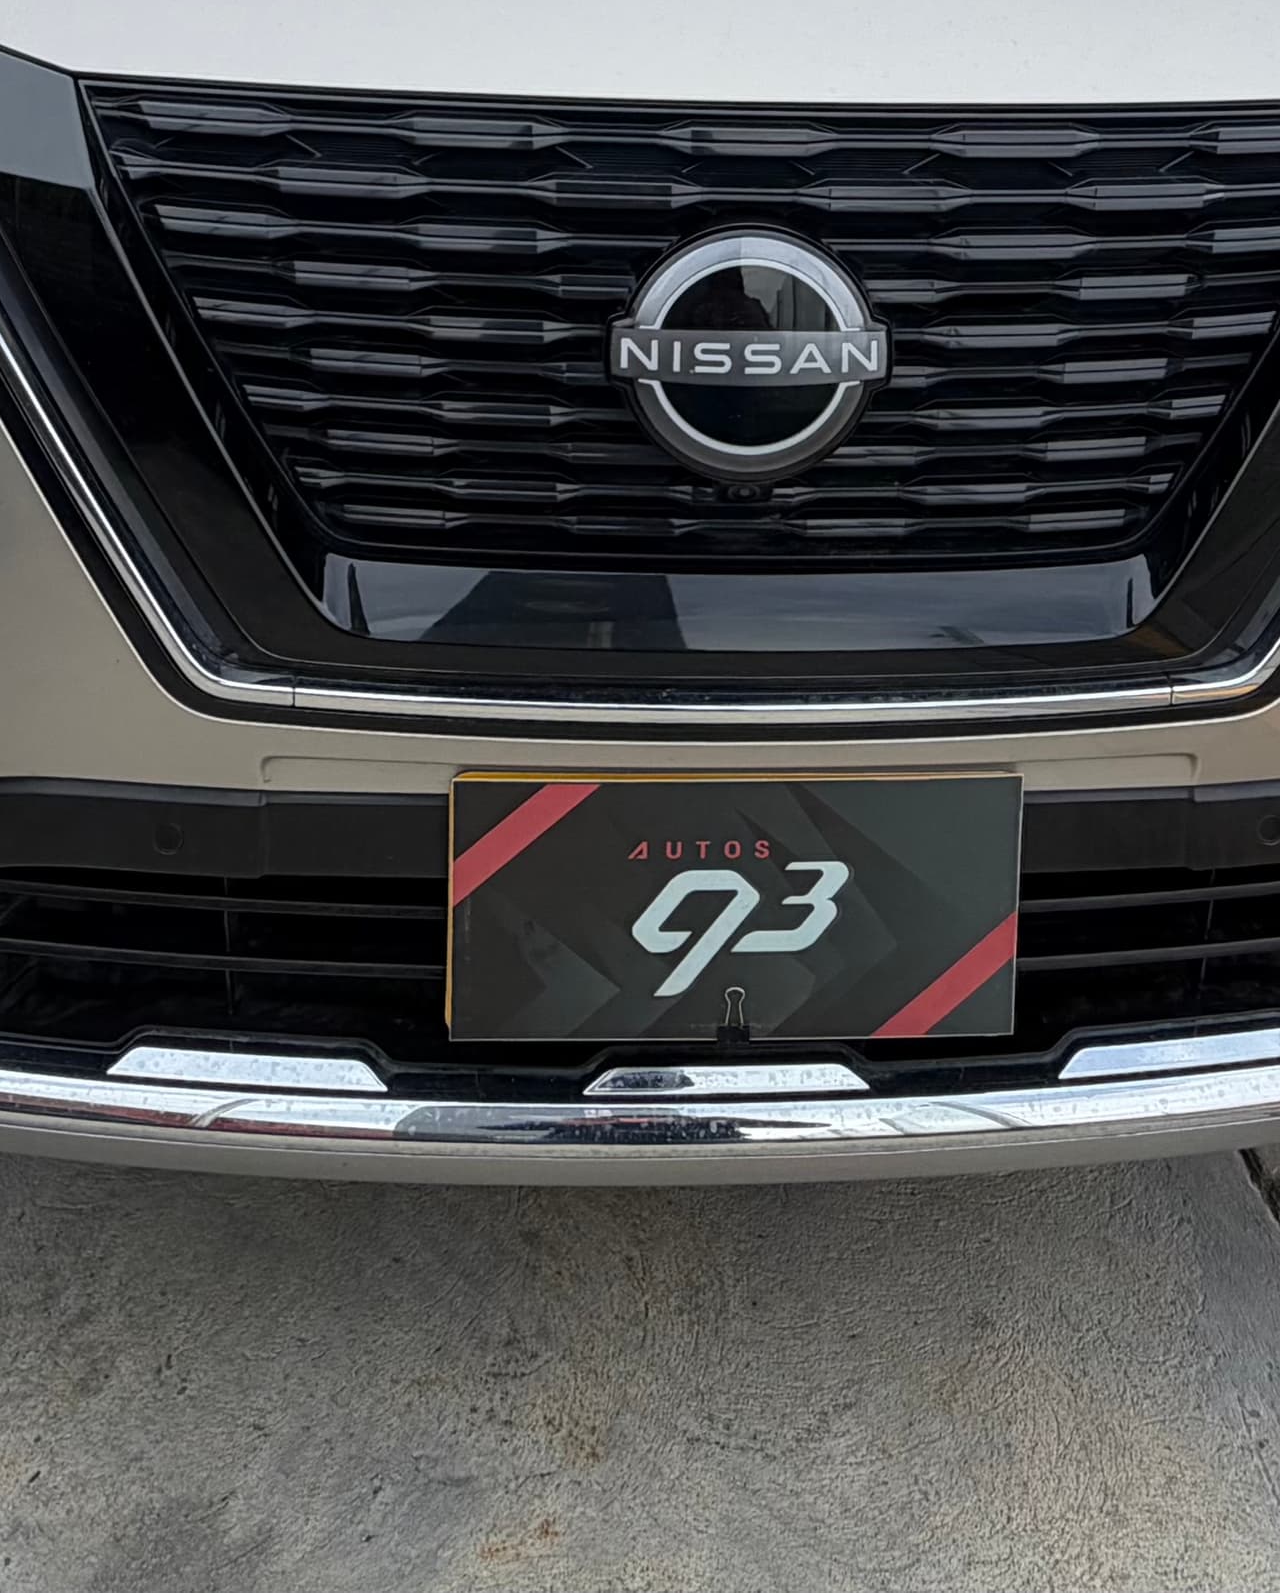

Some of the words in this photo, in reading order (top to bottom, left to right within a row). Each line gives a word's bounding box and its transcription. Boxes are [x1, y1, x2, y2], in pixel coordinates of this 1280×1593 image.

[620, 337, 878, 375] NISSAN
[627, 840, 771, 860] AUTOS
[631, 861, 849, 997] 93
